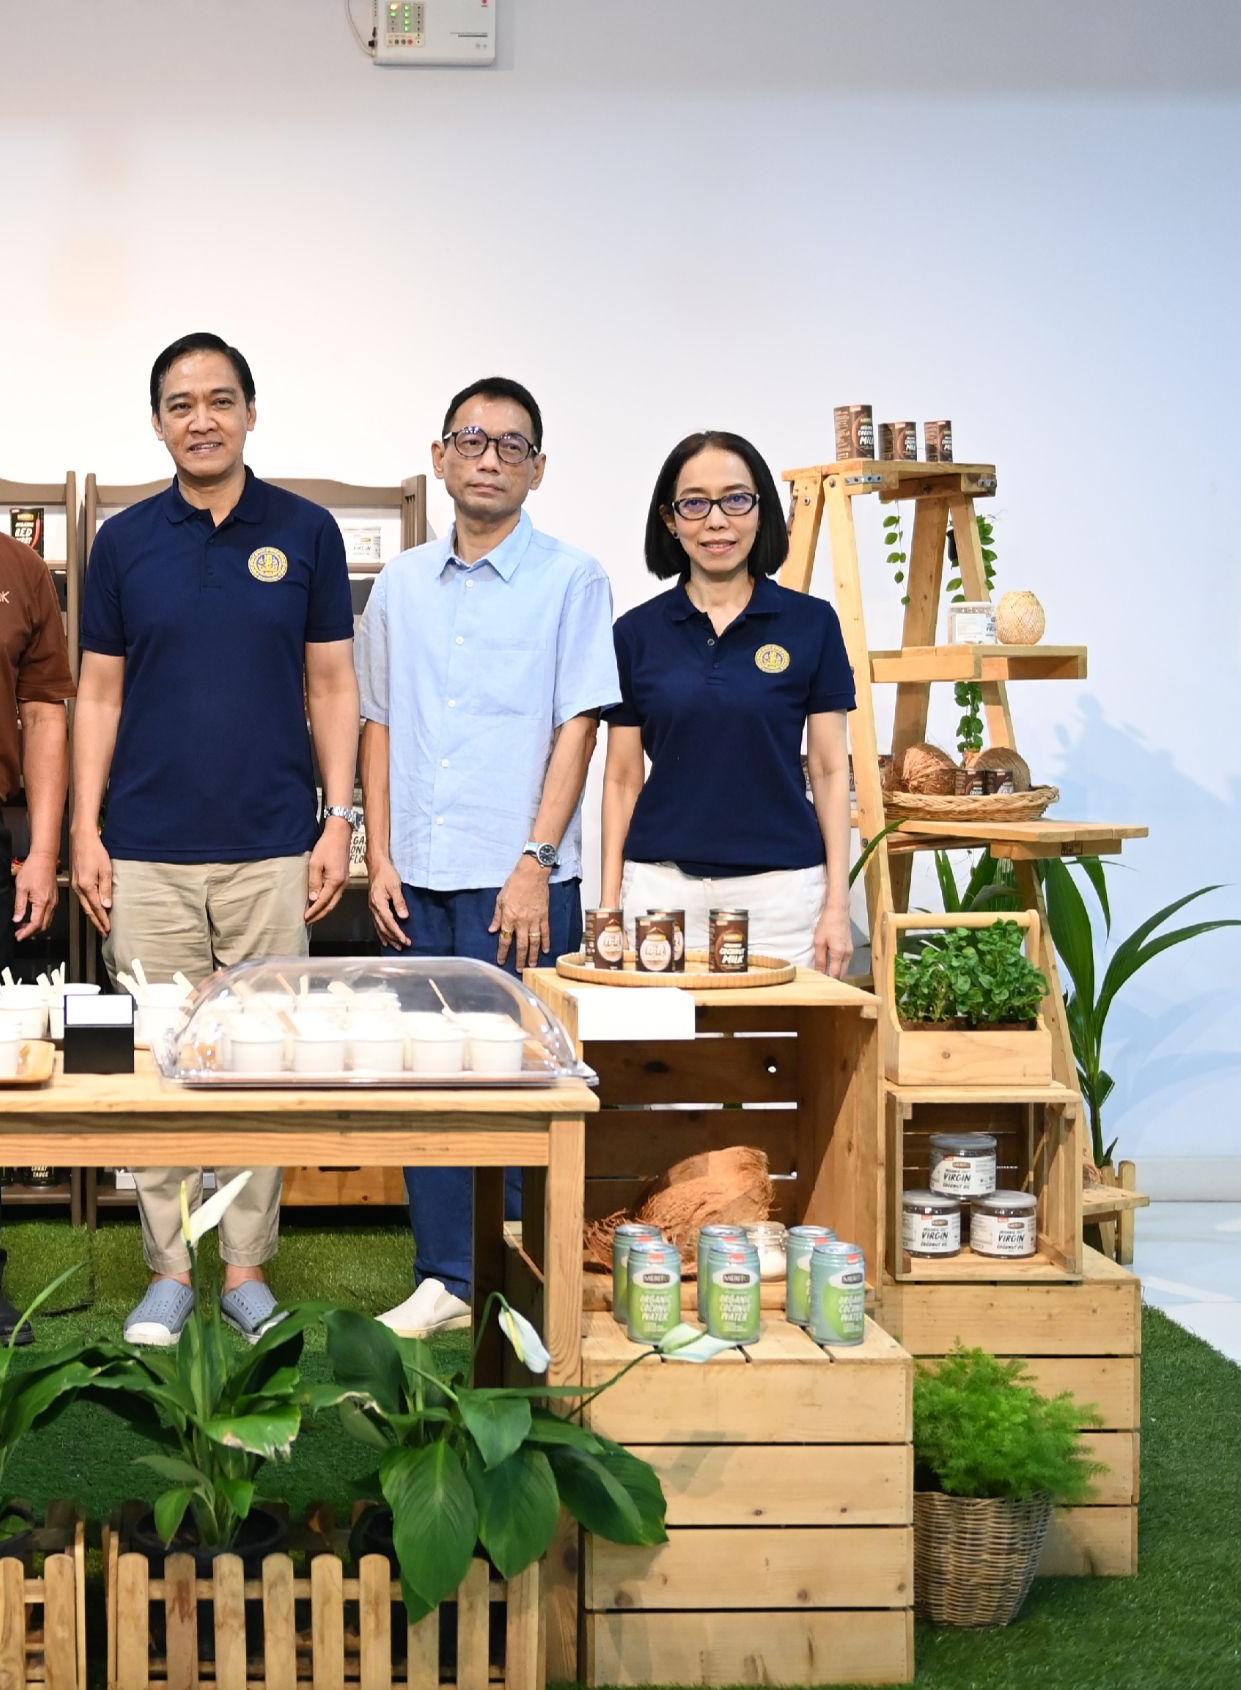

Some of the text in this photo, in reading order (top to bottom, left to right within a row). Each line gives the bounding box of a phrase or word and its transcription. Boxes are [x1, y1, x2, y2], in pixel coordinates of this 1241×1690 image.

[15, 528, 32, 537] RED
[722, 955, 744, 964] MILK
[944, 1173, 971, 1182] VIRGIN
[922, 1231, 948, 1240] VIRGIN
[999, 1234, 1025, 1242] VIRGIN
